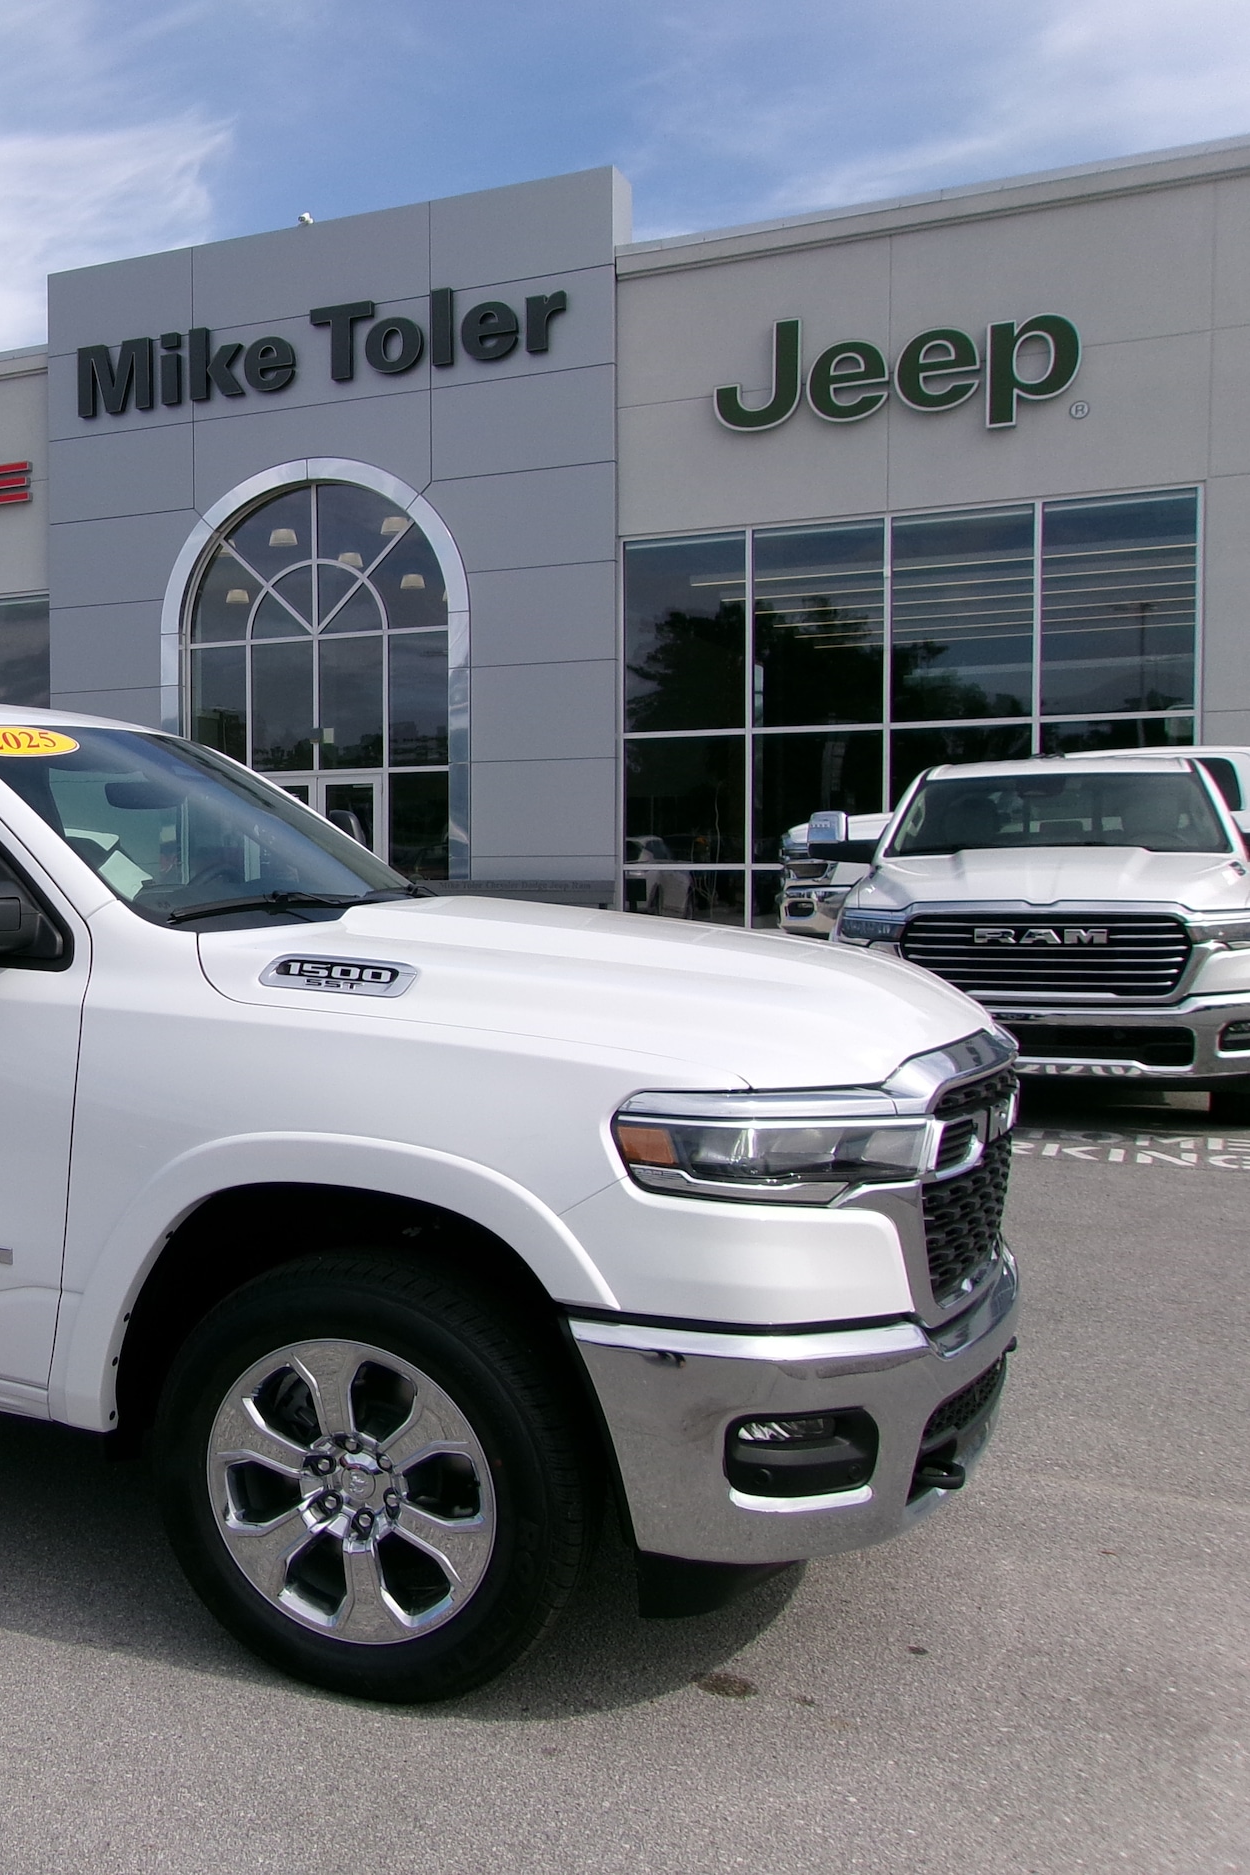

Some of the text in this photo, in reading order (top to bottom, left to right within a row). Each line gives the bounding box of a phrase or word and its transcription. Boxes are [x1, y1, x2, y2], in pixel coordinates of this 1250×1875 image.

[77, 287, 567, 419] Mike Toler
[713, 312, 1083, 432] Jeep
[973, 928, 1109, 945] RAM
[287, 961, 392, 983] 1500
[304, 978, 365, 991] SST
